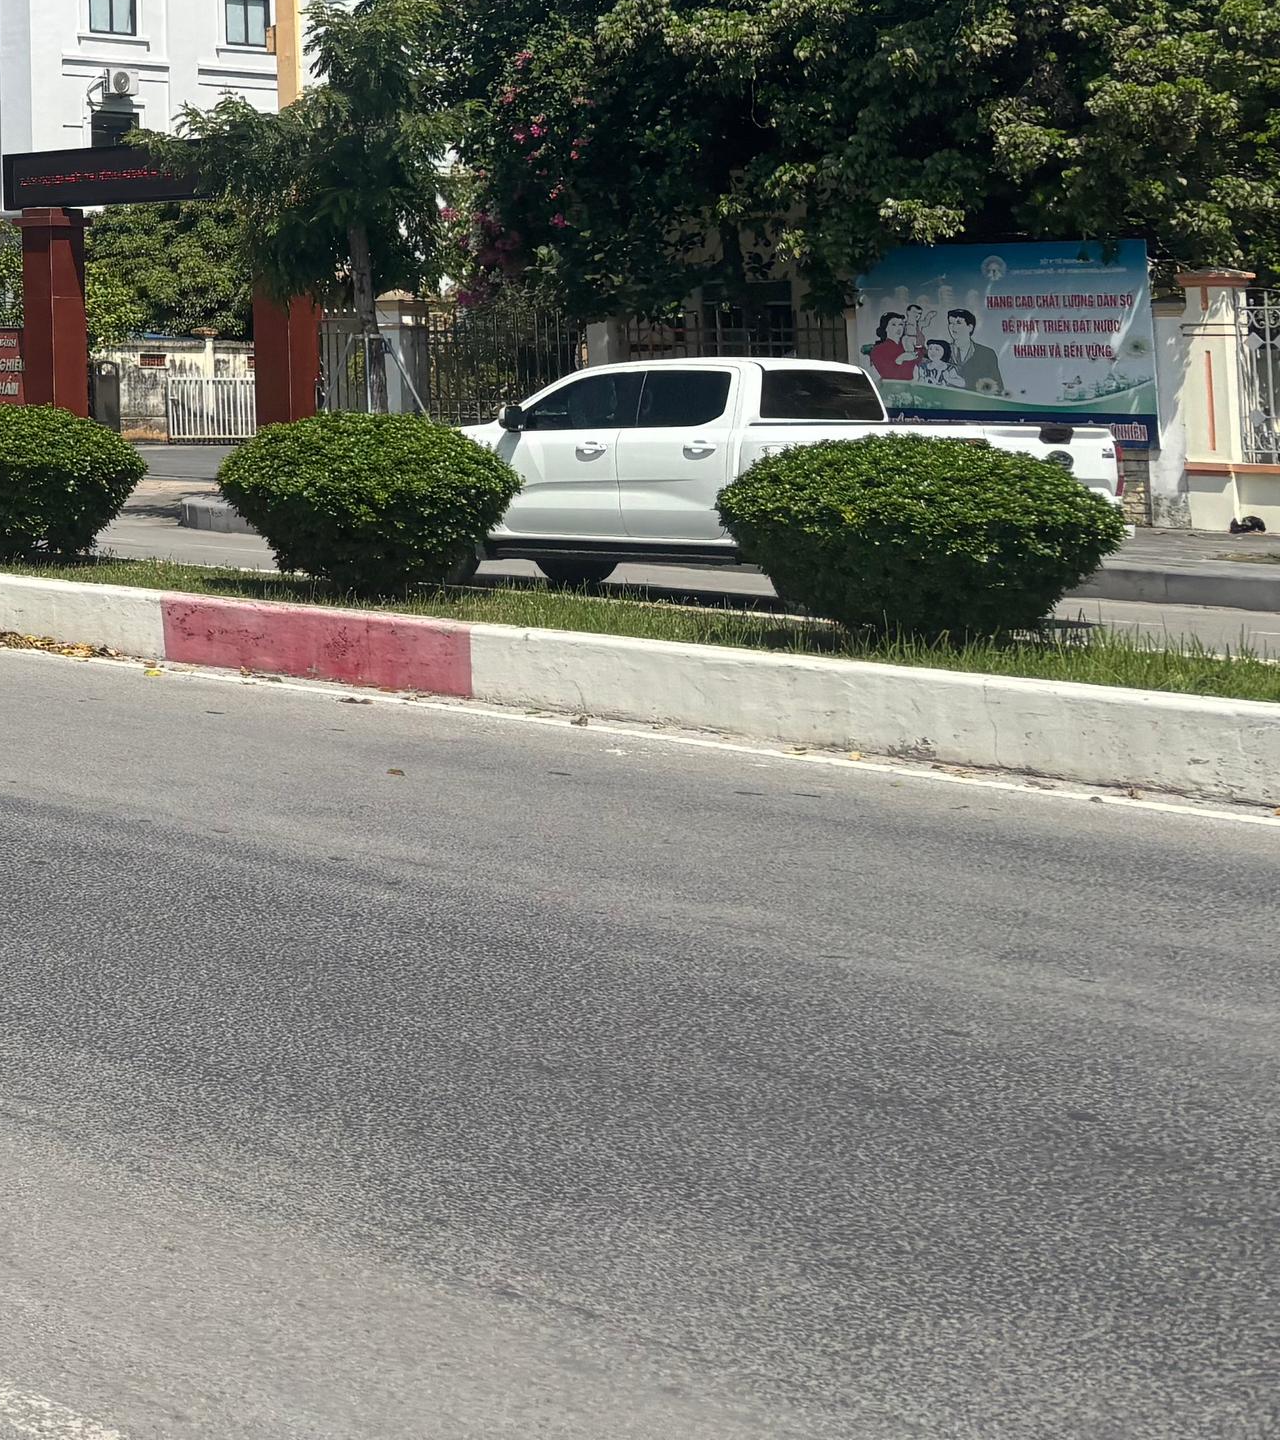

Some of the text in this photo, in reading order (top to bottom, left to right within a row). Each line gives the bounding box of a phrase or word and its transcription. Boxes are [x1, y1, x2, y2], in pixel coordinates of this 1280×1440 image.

[1015, 295, 1034, 308] CAO
[1036, 292, 1060, 309] CHẤT
[1063, 293, 1094, 310] LƯỢNG
[1097, 292, 1117, 308] DÂN
[1017, 315, 1040, 333] PHÁT
[1013, 344, 1047, 358] NHANH
[1048, 342, 1061, 358] VÀ
